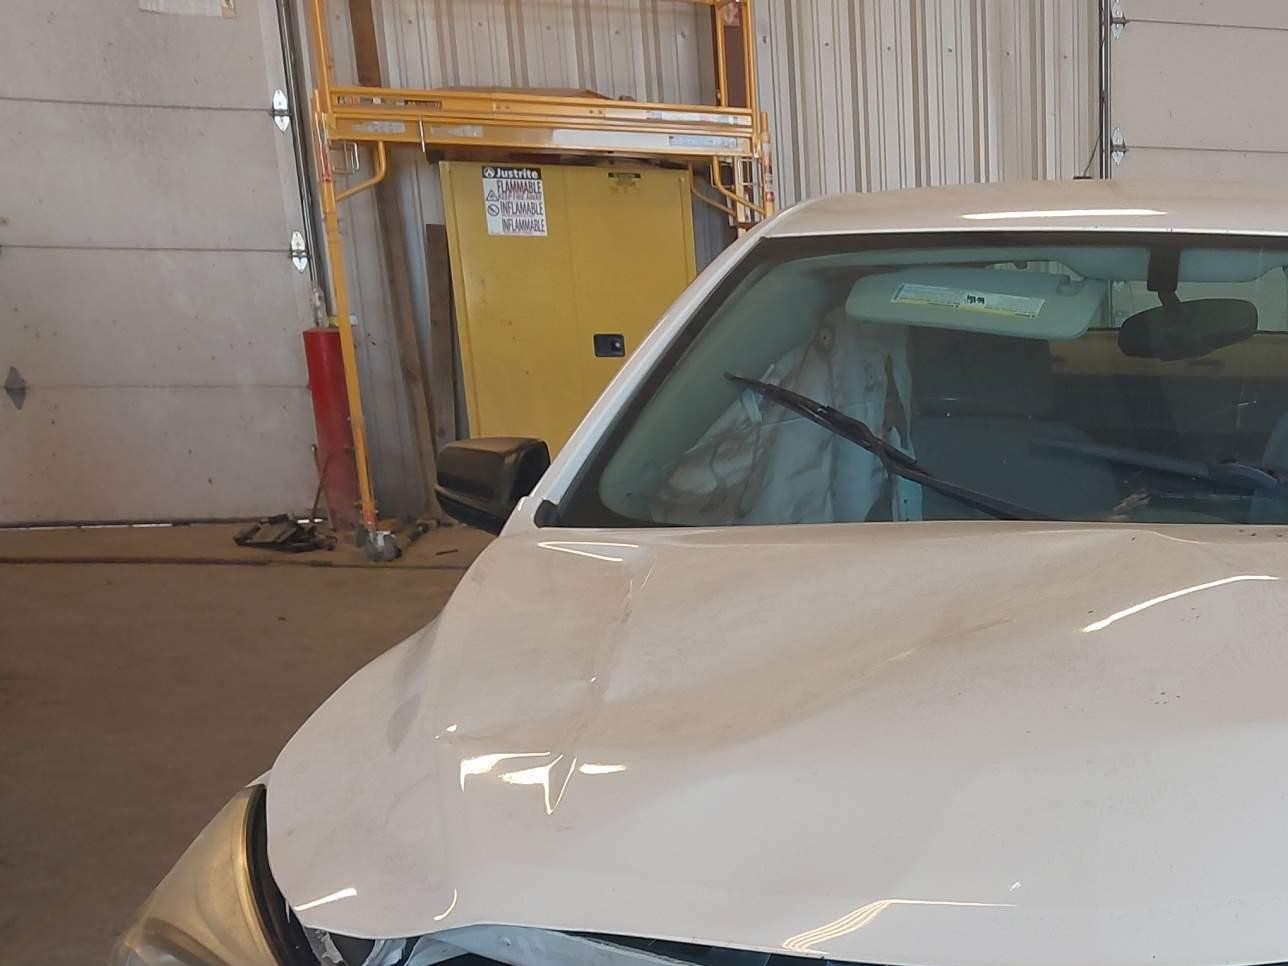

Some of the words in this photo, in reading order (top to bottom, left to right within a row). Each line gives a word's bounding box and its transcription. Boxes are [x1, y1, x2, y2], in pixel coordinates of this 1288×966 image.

[496, 168, 539, 179] Justrite
[497, 180, 542, 193] FLAMMABLE
[500, 201, 544, 215] INFLAMABLE
